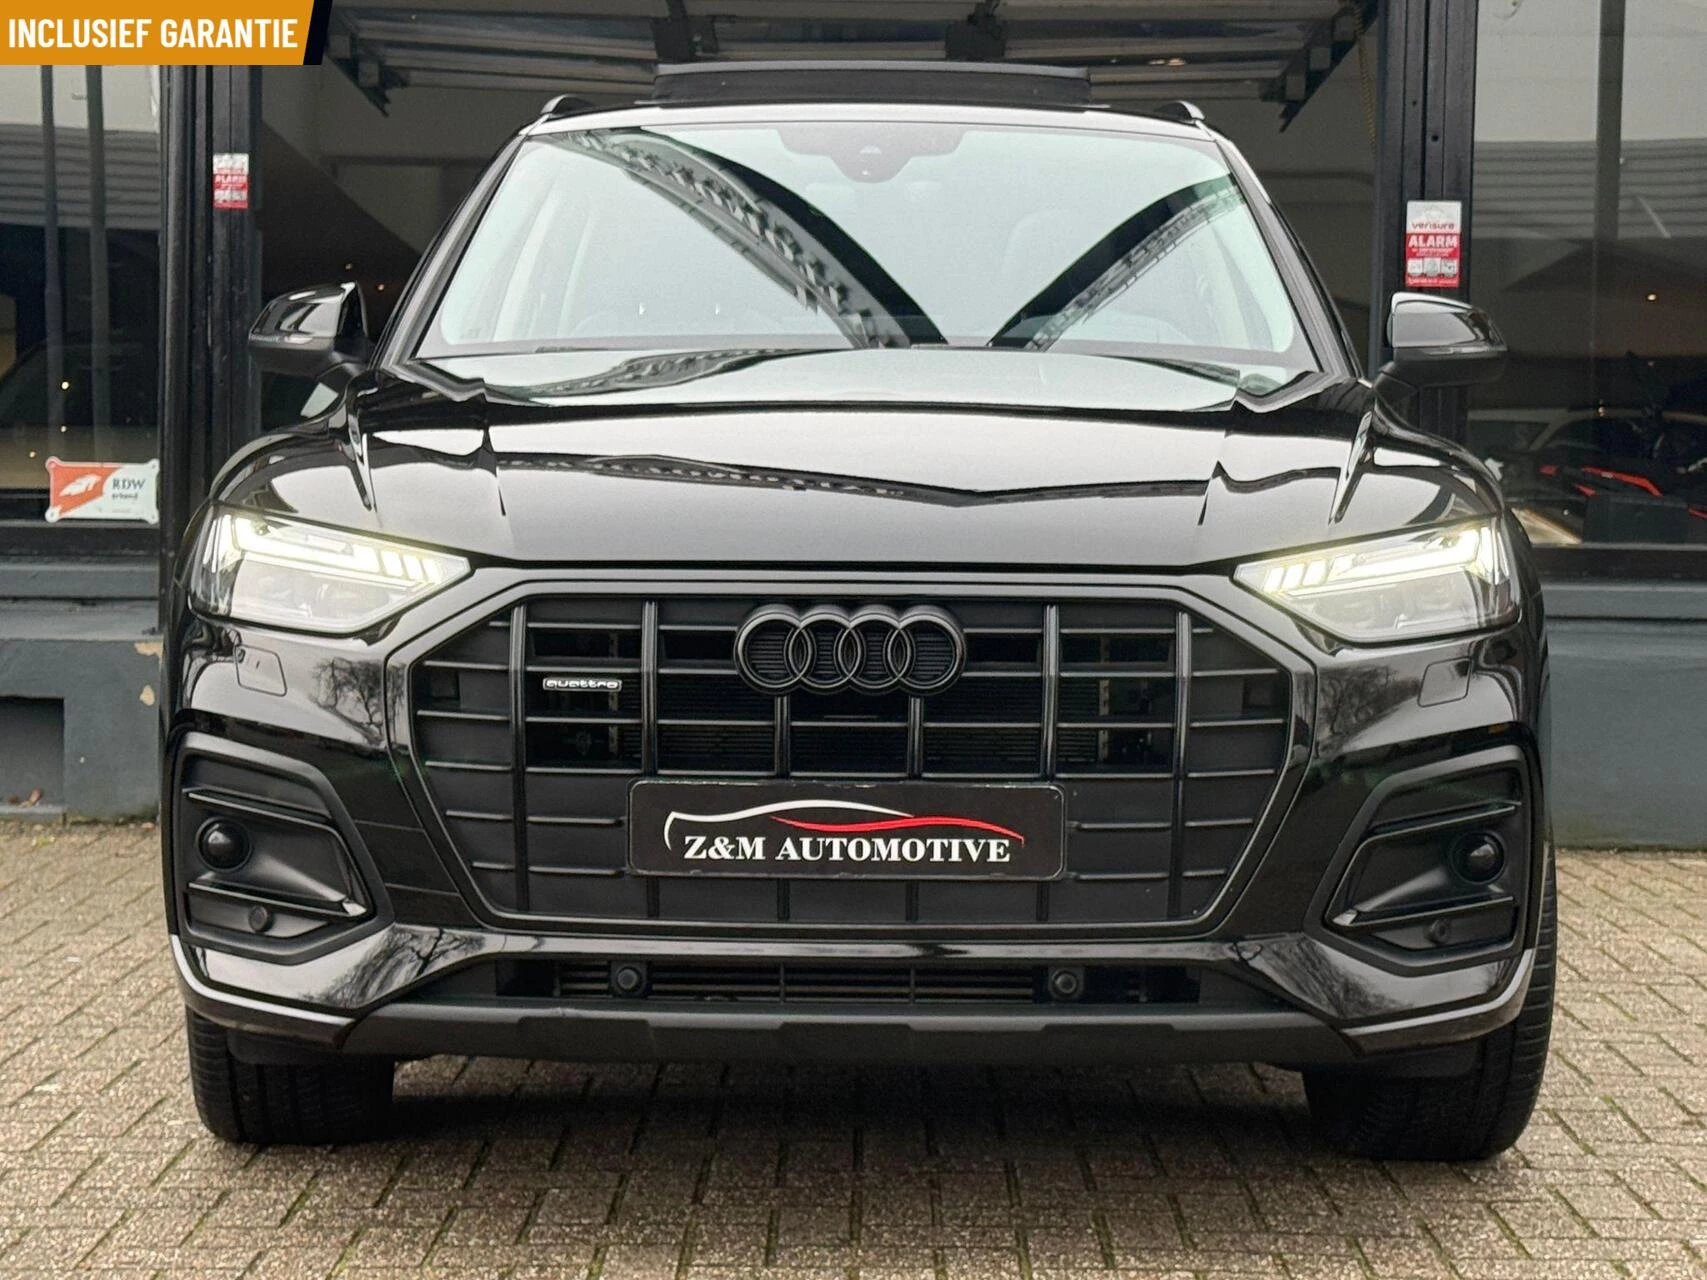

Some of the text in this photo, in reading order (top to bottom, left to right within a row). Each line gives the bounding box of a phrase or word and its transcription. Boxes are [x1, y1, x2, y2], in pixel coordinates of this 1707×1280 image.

[1411, 222, 1455, 230] verisure
[1408, 234, 1458, 248] ALARM
[112, 478, 146, 490] RDW
[546, 679, 618, 689] quattro
[683, 835, 1011, 863] Z&M AUTOMOTIVE
